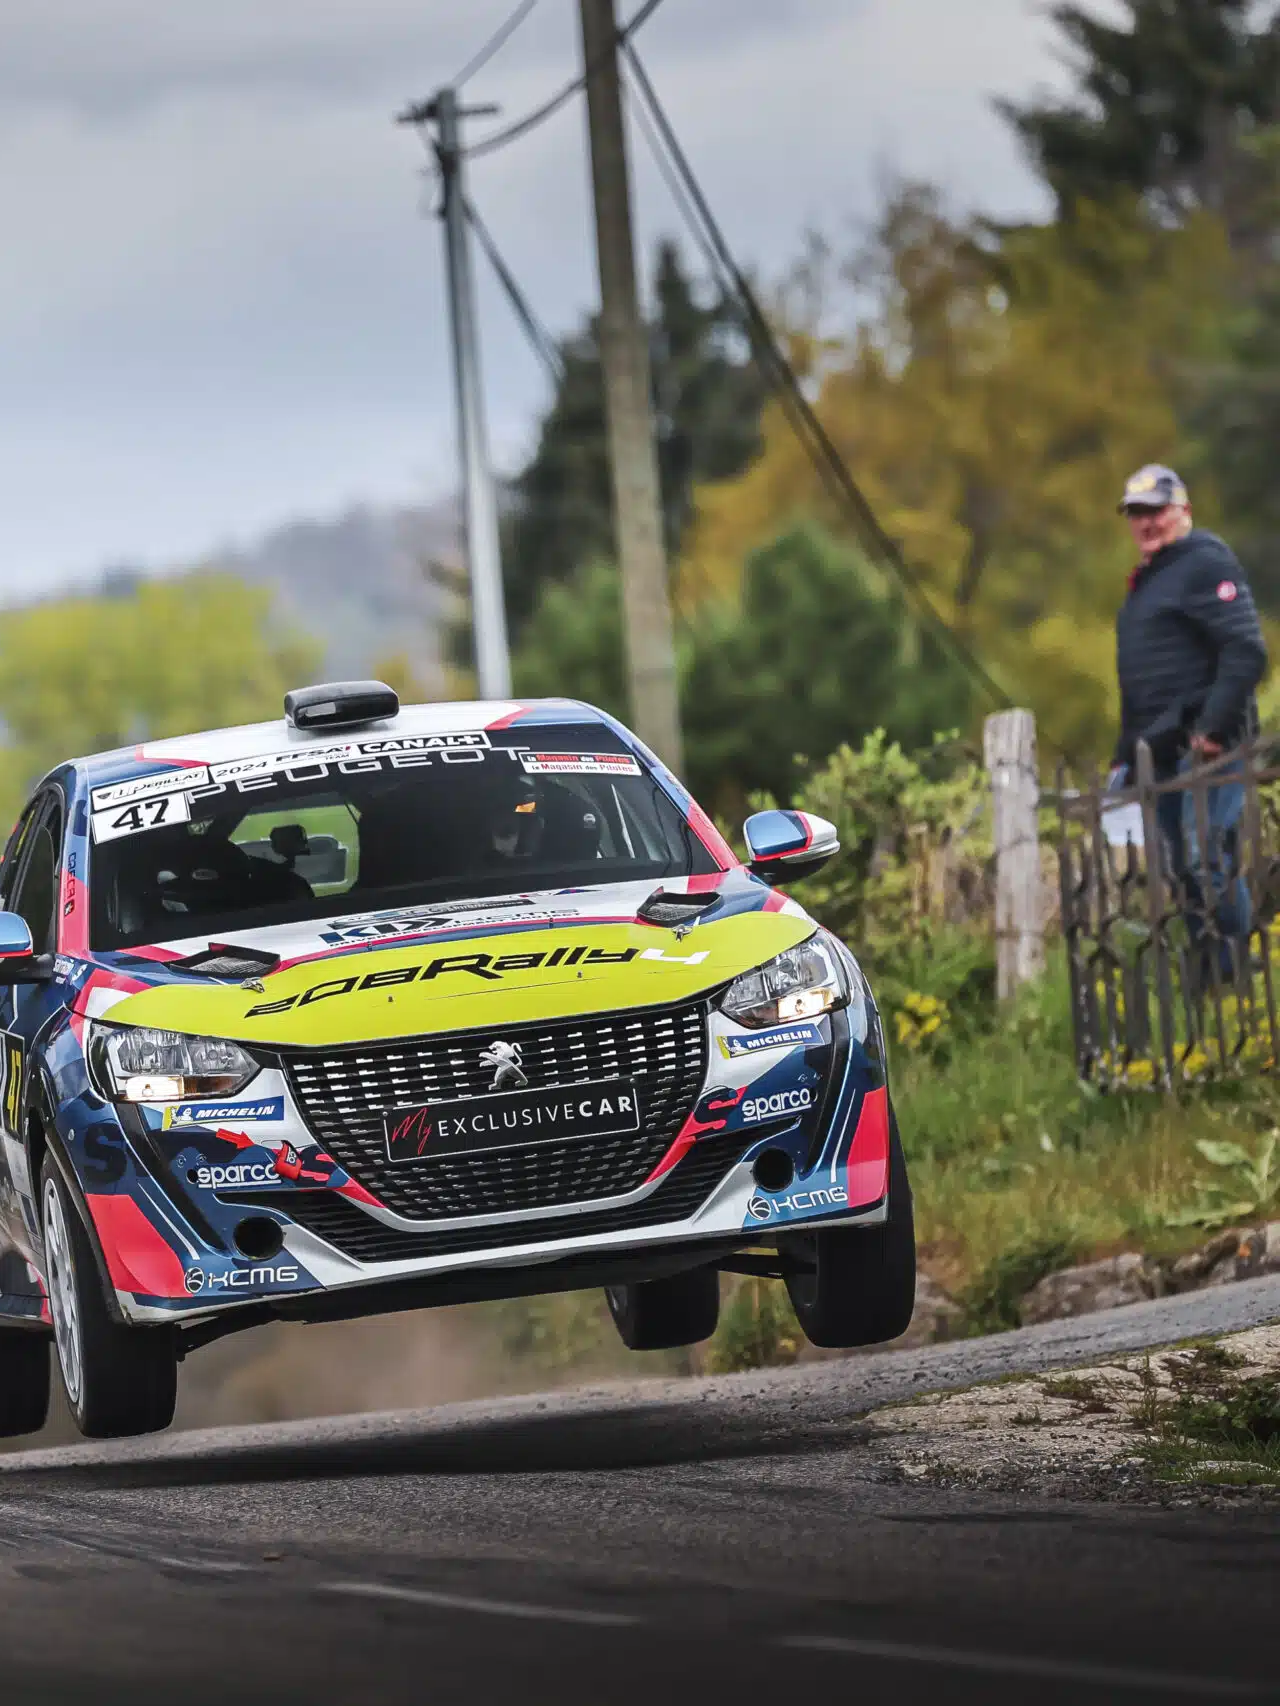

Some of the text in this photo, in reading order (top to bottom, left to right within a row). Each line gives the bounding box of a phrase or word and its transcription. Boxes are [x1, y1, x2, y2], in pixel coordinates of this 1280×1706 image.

[216, 762, 267, 778] 2024
[362, 735, 480, 752] CANAL+
[186, 747, 530, 804] PEUGEOT
[111, 798, 170, 831] 47
[746, 1030, 813, 1048] MICHELIN
[195, 1105, 276, 1118] MICHELIN
[742, 1087, 811, 1121] sparco
[391, 1107, 432, 1155] My
[197, 1163, 281, 1190] sparco
[773, 1187, 849, 1214] KCMG
[208, 1265, 299, 1289] KCMG
